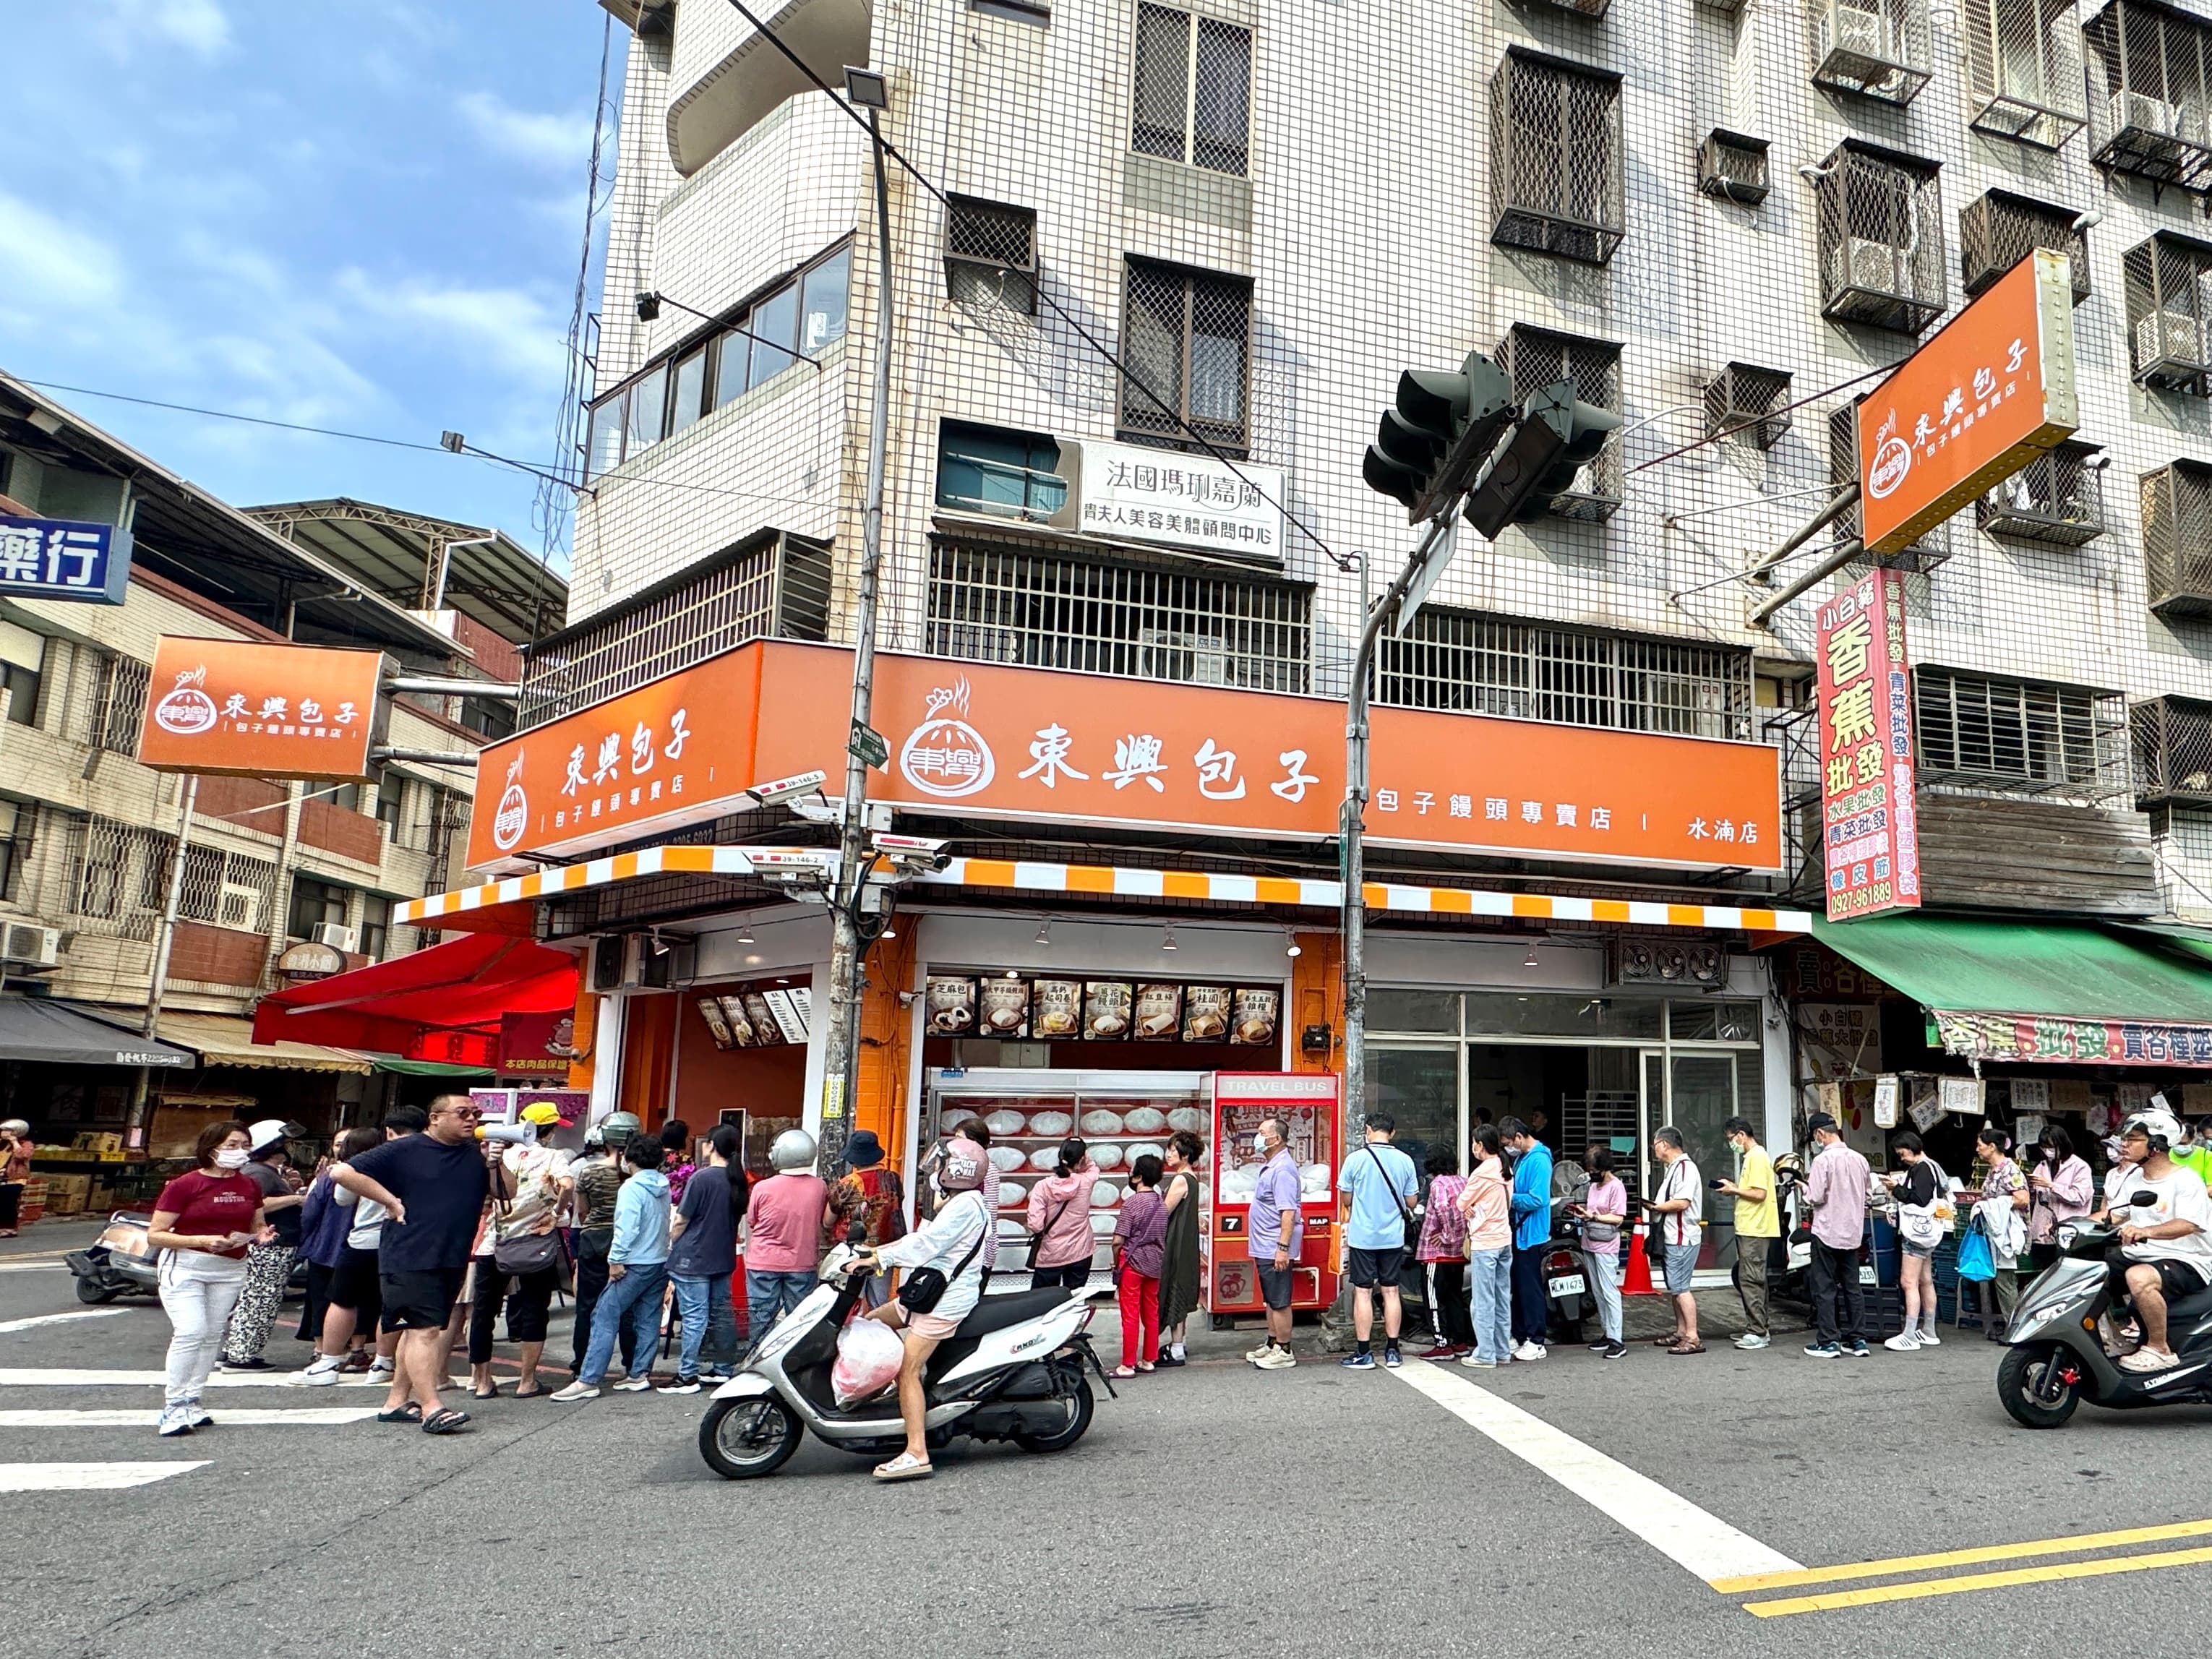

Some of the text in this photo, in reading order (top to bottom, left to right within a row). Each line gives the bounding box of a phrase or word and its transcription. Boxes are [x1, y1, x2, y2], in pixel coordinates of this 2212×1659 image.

[1912, 338, 2028, 450] 東興包子
[0, 525, 100, 586] 藥行
[1885, 580, 1905, 664] 香蕉批發
[1827, 612, 1877, 754] 香蕉
[220, 693, 359, 724] 東興包子
[236, 722, 342, 739] 包子饅頭專賣店
[1889, 672, 1909, 757] 青菜批發
[561, 708, 691, 797] 東興包子
[1019, 722, 1320, 802] 東興包子
[1827, 741, 1885, 797] 批發
[555, 774, 683, 828] 包子饅頭專賣店
[1376, 787, 1611, 831] 包子饅頭專賣店
[1828, 784, 1885, 821] 水果批發
[1687, 817, 1758, 844] 水湳店
[1829, 809, 1887, 845] 青菜批發
[1831, 857, 1890, 892] 橡皮筋
[1831, 881, 1891, 914] 0927-961889
[2034, 1016, 2110, 1060] 批發
[505, 1059, 571, 1070] 本店肉品保證
[1225, 1081, 1327, 1092] TRAVEL BUS
[1225, 1218, 1238, 1230] 7
